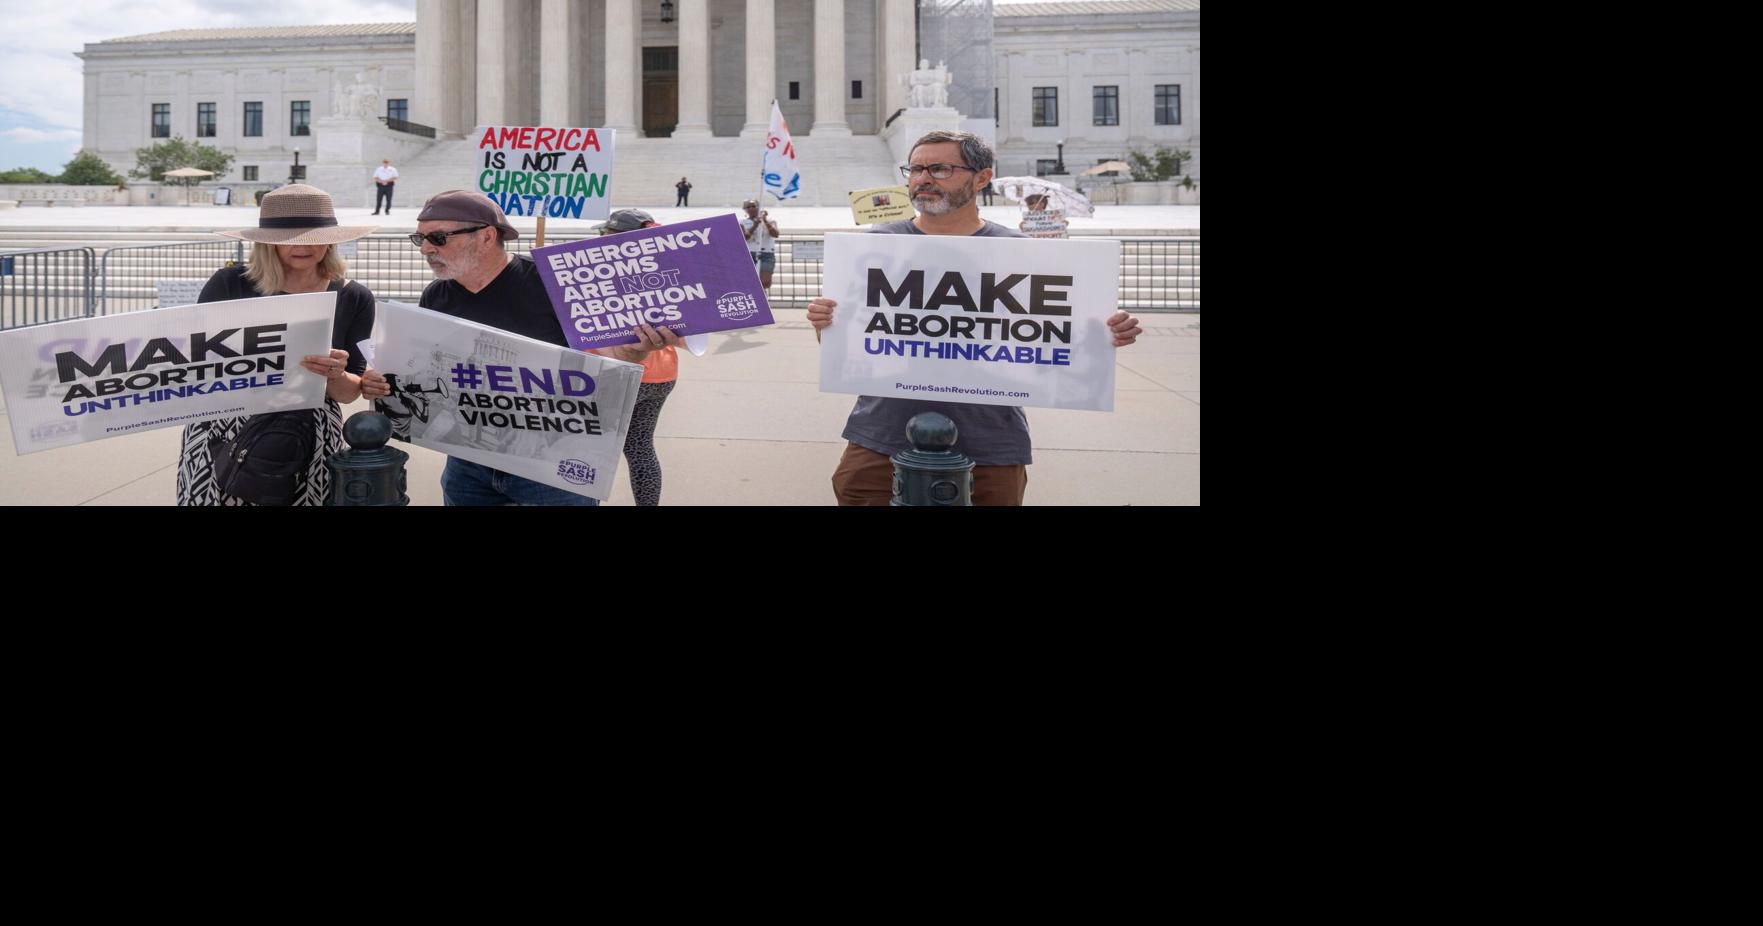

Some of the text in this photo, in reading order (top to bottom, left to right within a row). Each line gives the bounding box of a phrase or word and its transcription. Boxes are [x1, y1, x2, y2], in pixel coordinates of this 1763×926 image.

[480, 127, 600, 152] AMERICA
[485, 151, 588, 172] IS NOT A
[479, 169, 608, 198] CHRISTIAN
[488, 191, 585, 219] NATION
[547, 228, 711, 270] EMERGENCY
[554, 256, 659, 286] ROOMS
[564, 269, 680, 302] ARE NOT
[866, 268, 1073, 316] MAKE
[570, 283, 707, 318] ABORTION
[717, 300, 757, 313] SASH
[720, 309, 759, 318] REVOLUTION
[575, 305, 682, 333] CLINICS
[864, 312, 1071, 344] ABORTION
[55, 323, 287, 383] MAKE
[864, 338, 1071, 366] UNTHINKABLE
[61, 355, 285, 403] ABORTION
[451, 363, 596, 397] #END
[895, 383, 1030, 398] PurpleSashRevolution.com
[63, 373, 284, 416] UNTHINKABLE
[458, 393, 599, 417] ABORTION
[106, 406, 245, 433] PurpleSashRevolution.com
[459, 410, 602, 435] VIOLENCE
[558, 465, 596, 480] SASH
